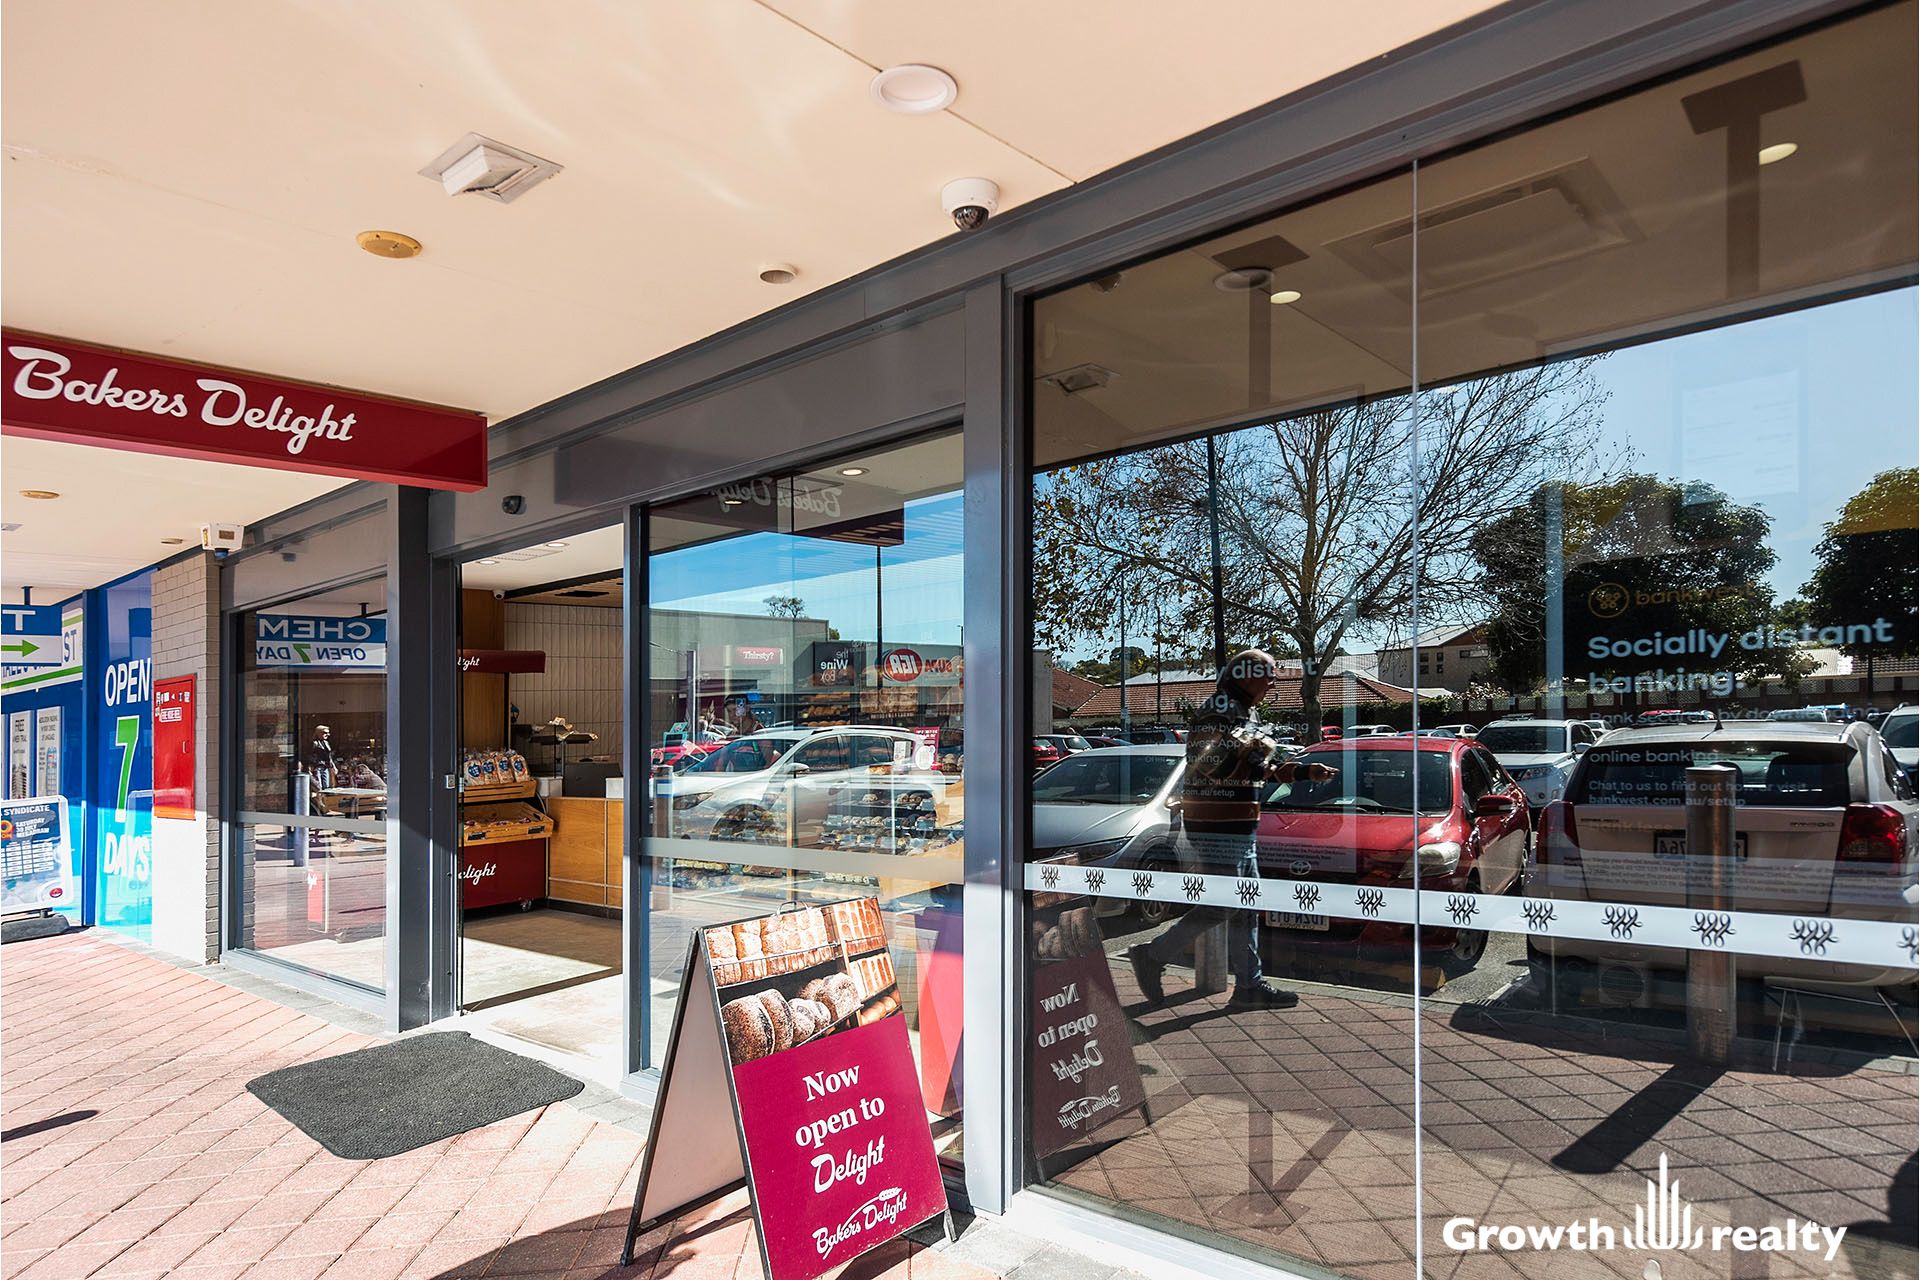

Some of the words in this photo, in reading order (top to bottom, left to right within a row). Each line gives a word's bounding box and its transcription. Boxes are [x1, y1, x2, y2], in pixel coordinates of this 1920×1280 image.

[8, 346, 188, 418] Bakers
[197, 378, 358, 455] Delight
[743, 650, 775, 662] Thirsty?
[1587, 628, 1728, 658] Socially
[1739, 617, 1896, 650] distant
[104, 657, 151, 707] OPEN
[1588, 668, 1746, 698] banking.
[115, 715, 140, 822] 7
[1589, 750, 1641, 763] online
[1588, 780, 1617, 792] Chat
[1620, 781, 1633, 792] to
[1636, 783, 1652, 792] us
[1655, 781, 1668, 792] to
[1670, 780, 1697, 792] find
[1699, 781, 1722, 792] out
[4, 804, 50, 816] SYNDICATE
[103, 832, 150, 882] DAYS
[802, 1064, 860, 1102] Now
[795, 1107, 858, 1149] open
[859, 1096, 886, 1122] to
[810, 1136, 886, 1194] Delight
[811, 1220, 862, 1256] Bakers
[863, 1192, 909, 1232] Delight
